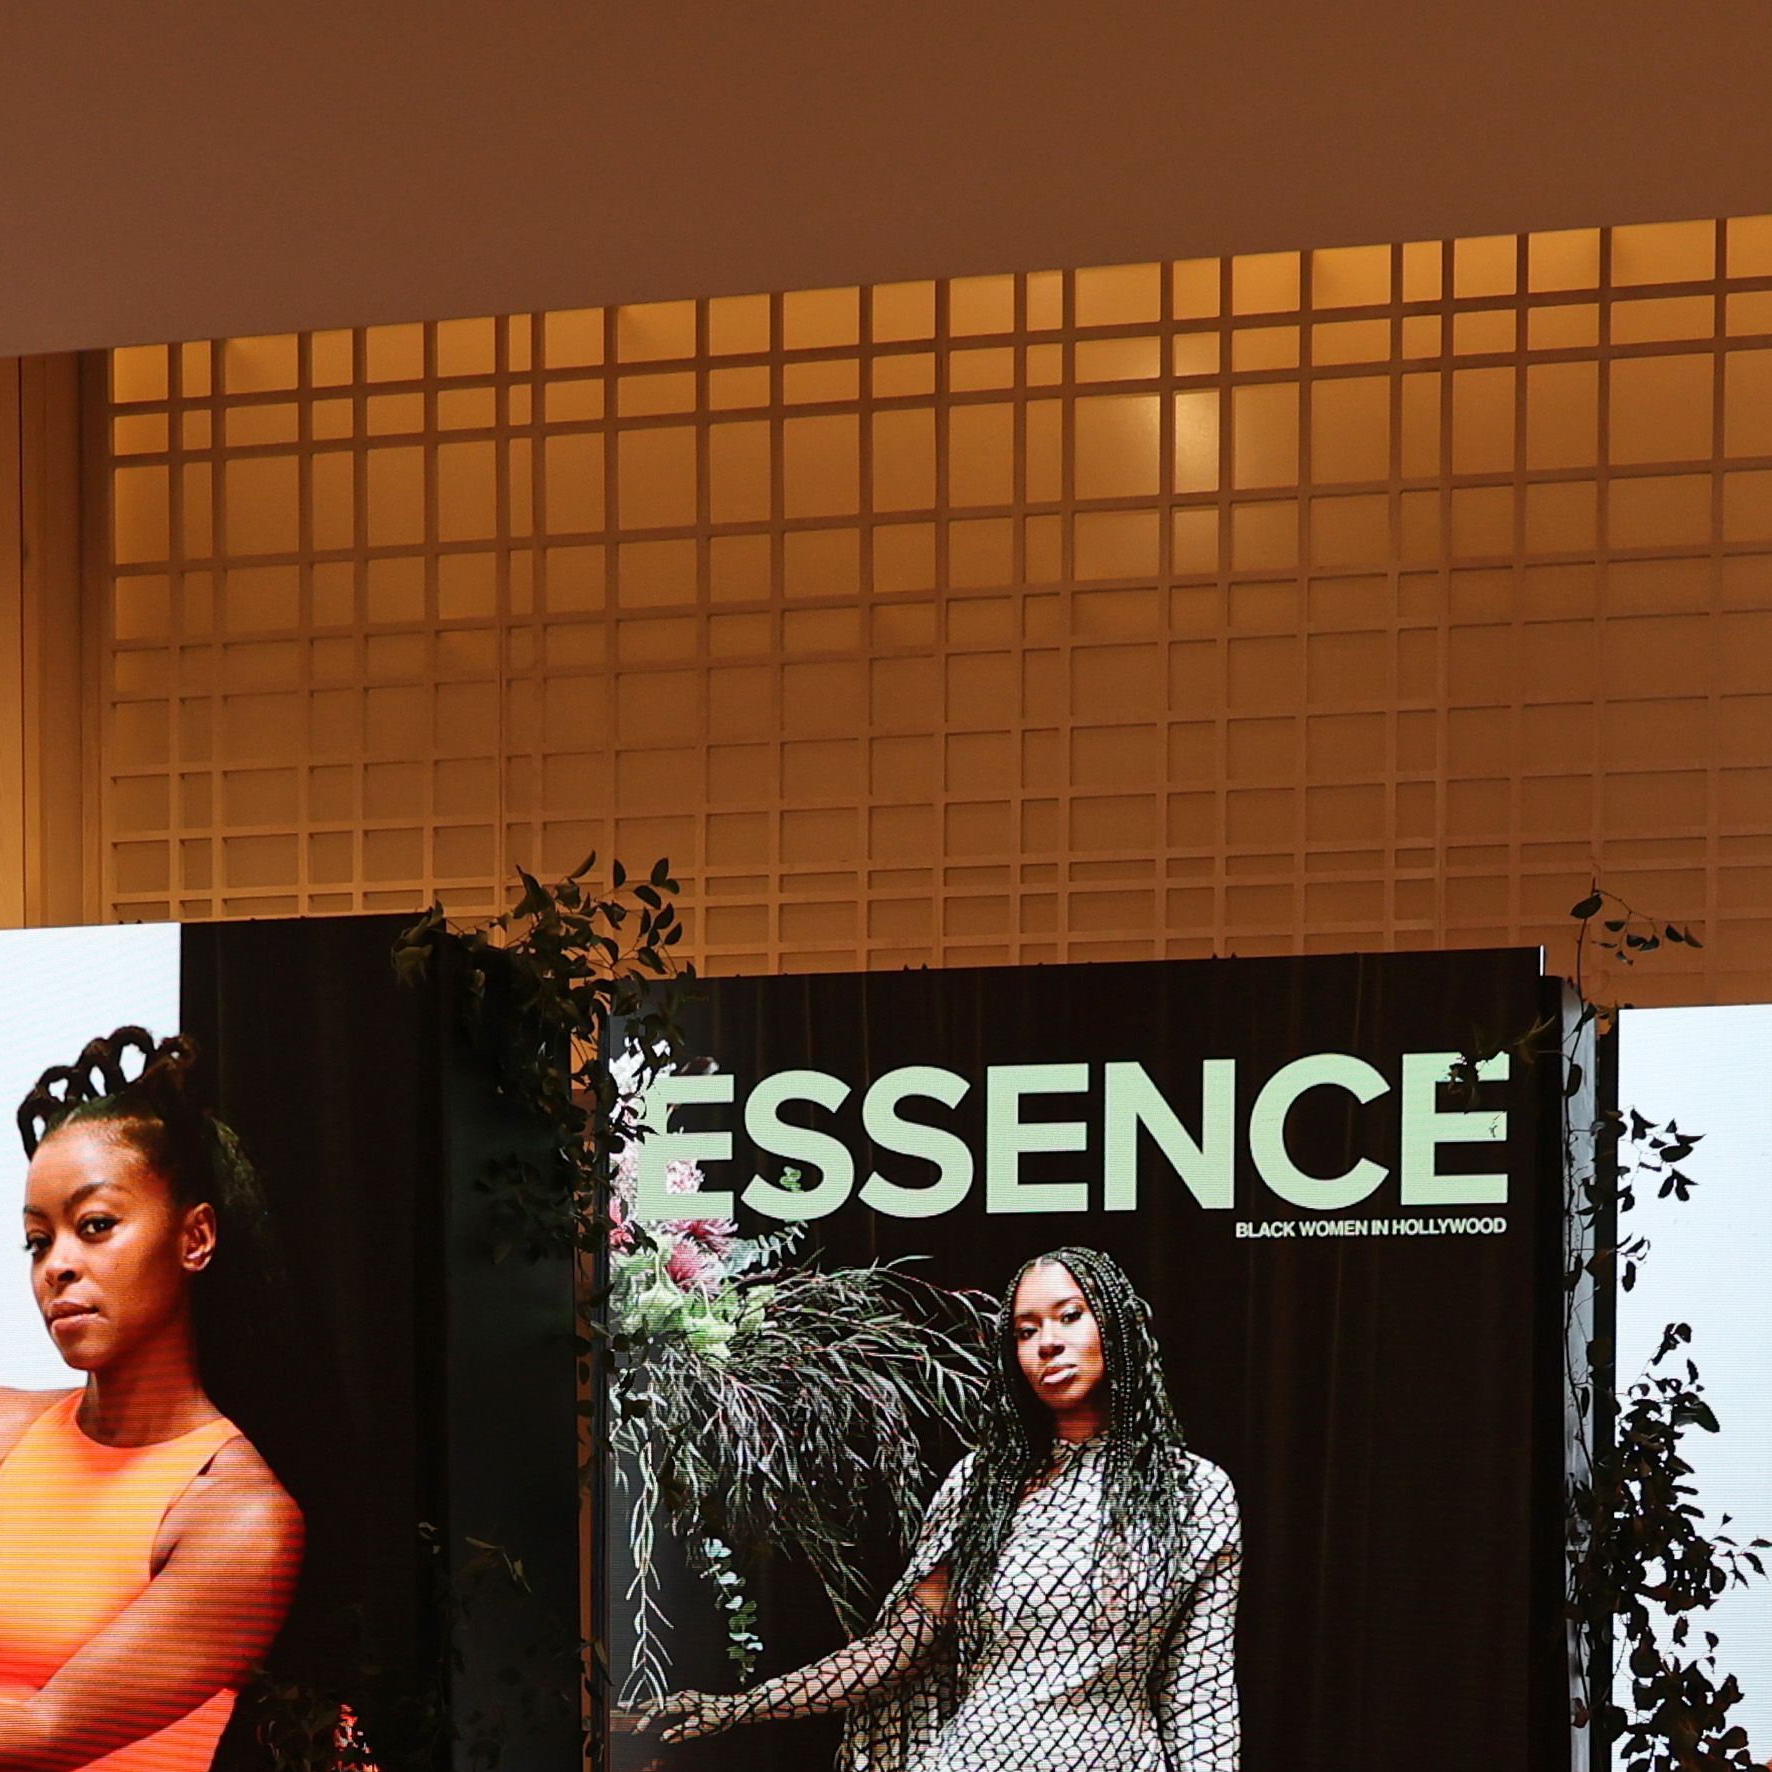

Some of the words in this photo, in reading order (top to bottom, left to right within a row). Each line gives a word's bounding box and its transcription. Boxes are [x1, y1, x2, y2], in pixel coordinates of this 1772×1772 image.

[637, 1051, 1510, 1220] ESSENCE
[1235, 1221, 1296, 1238] BLACK
[1298, 1219, 1368, 1238] WOMEN
[1371, 1219, 1388, 1237] IN
[1392, 1217, 1507, 1237] HOLLYWOOD
